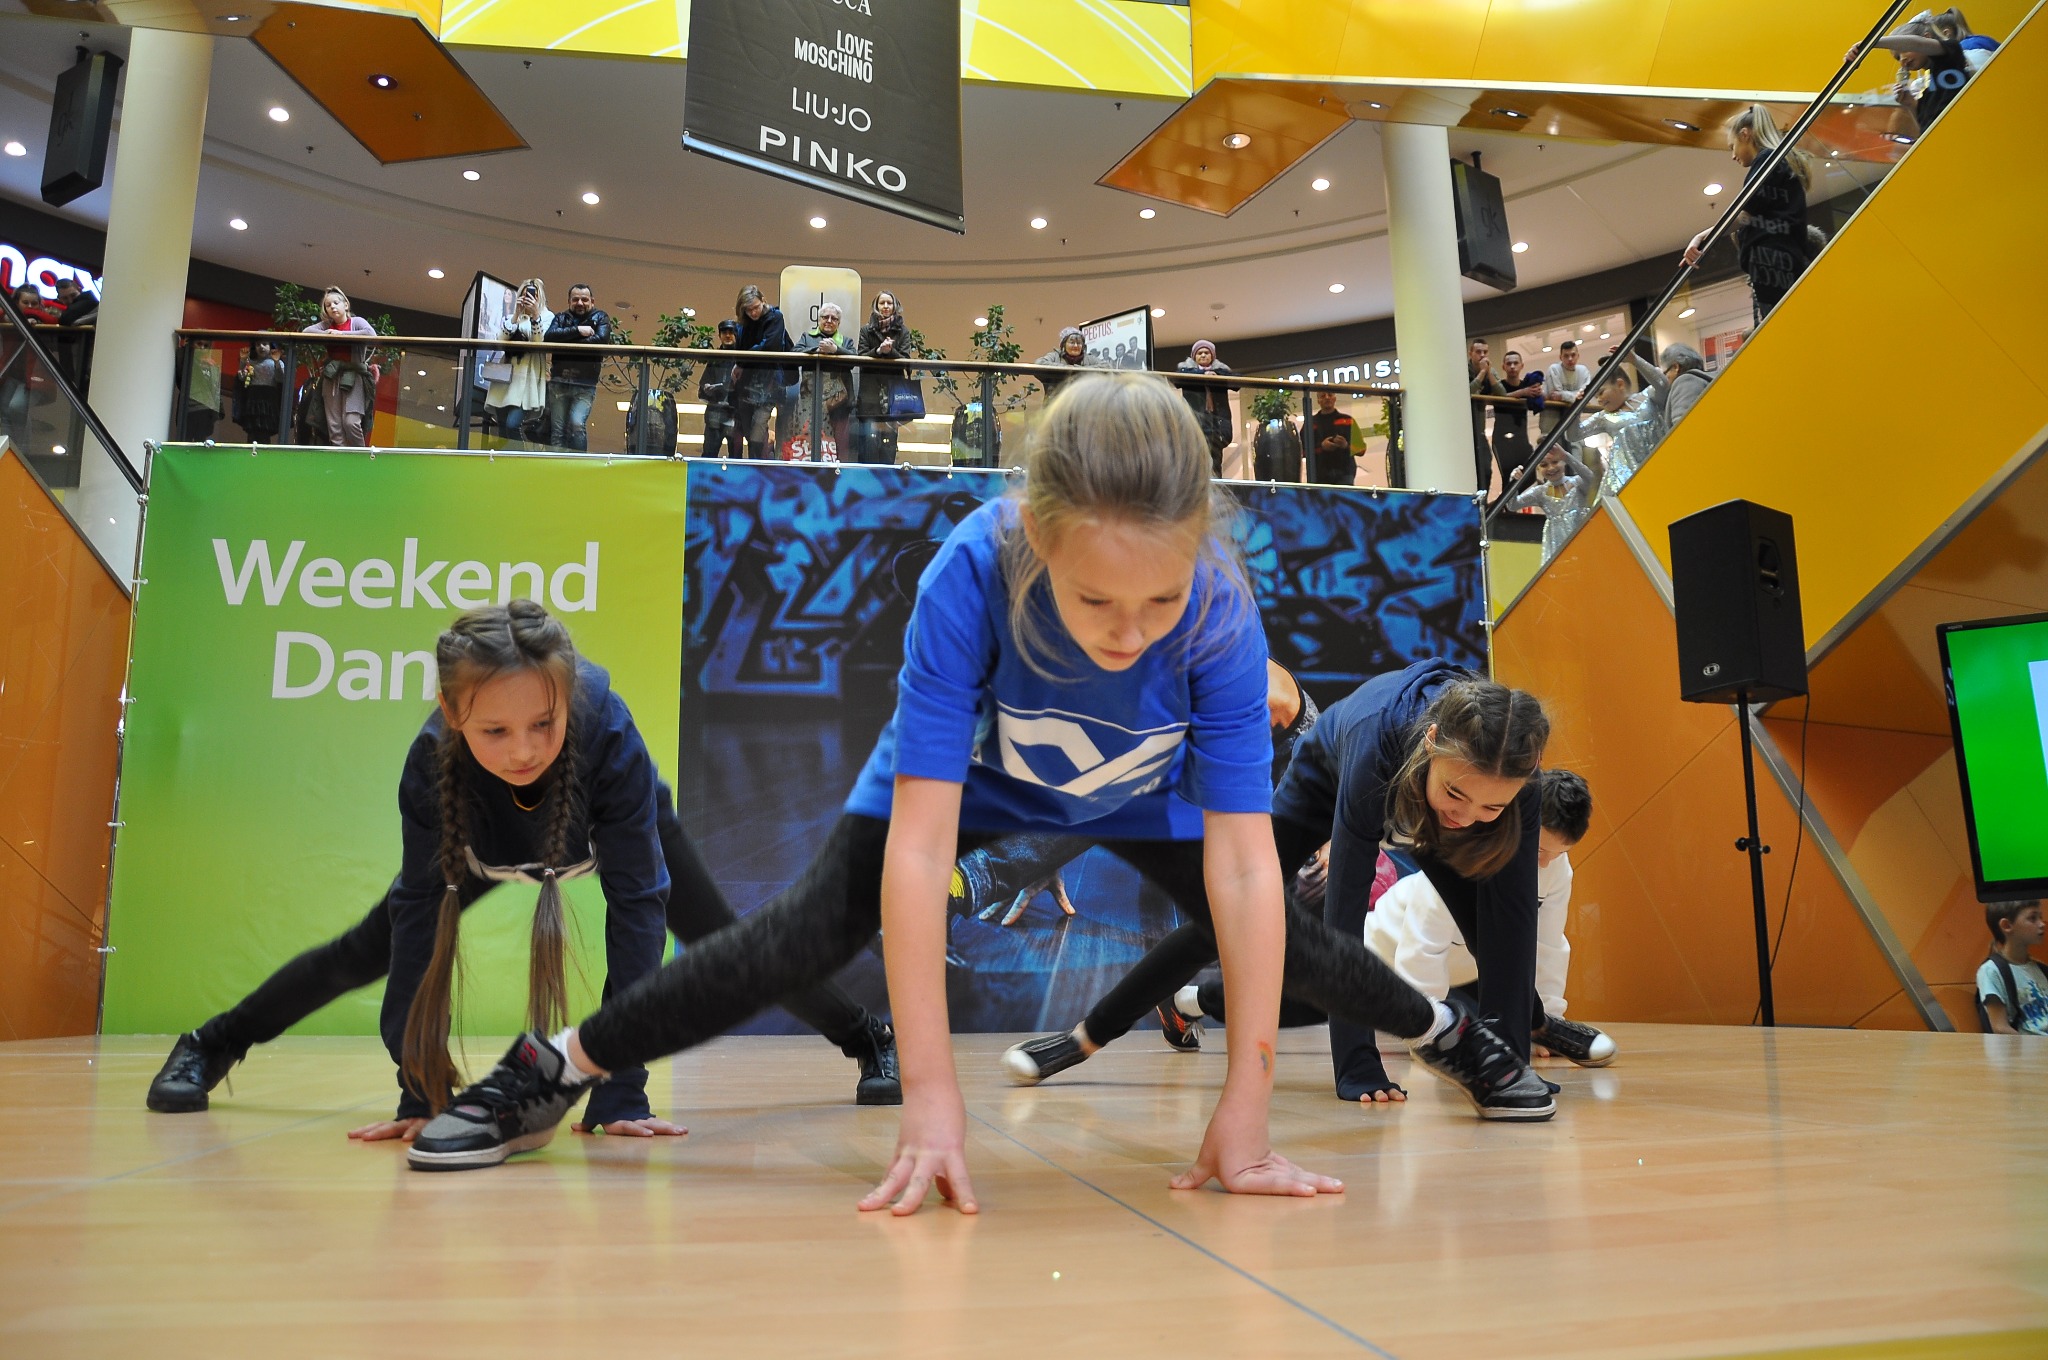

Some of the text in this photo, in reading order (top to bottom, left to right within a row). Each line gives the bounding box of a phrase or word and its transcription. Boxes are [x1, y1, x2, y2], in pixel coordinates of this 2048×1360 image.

[794, 36, 873, 84] MOSCHINO
[836, 29, 873, 62] LOVE
[759, 125, 907, 192] PINKO
[791, 440, 837, 457] Stre
[212, 537, 600, 613] Weekend
